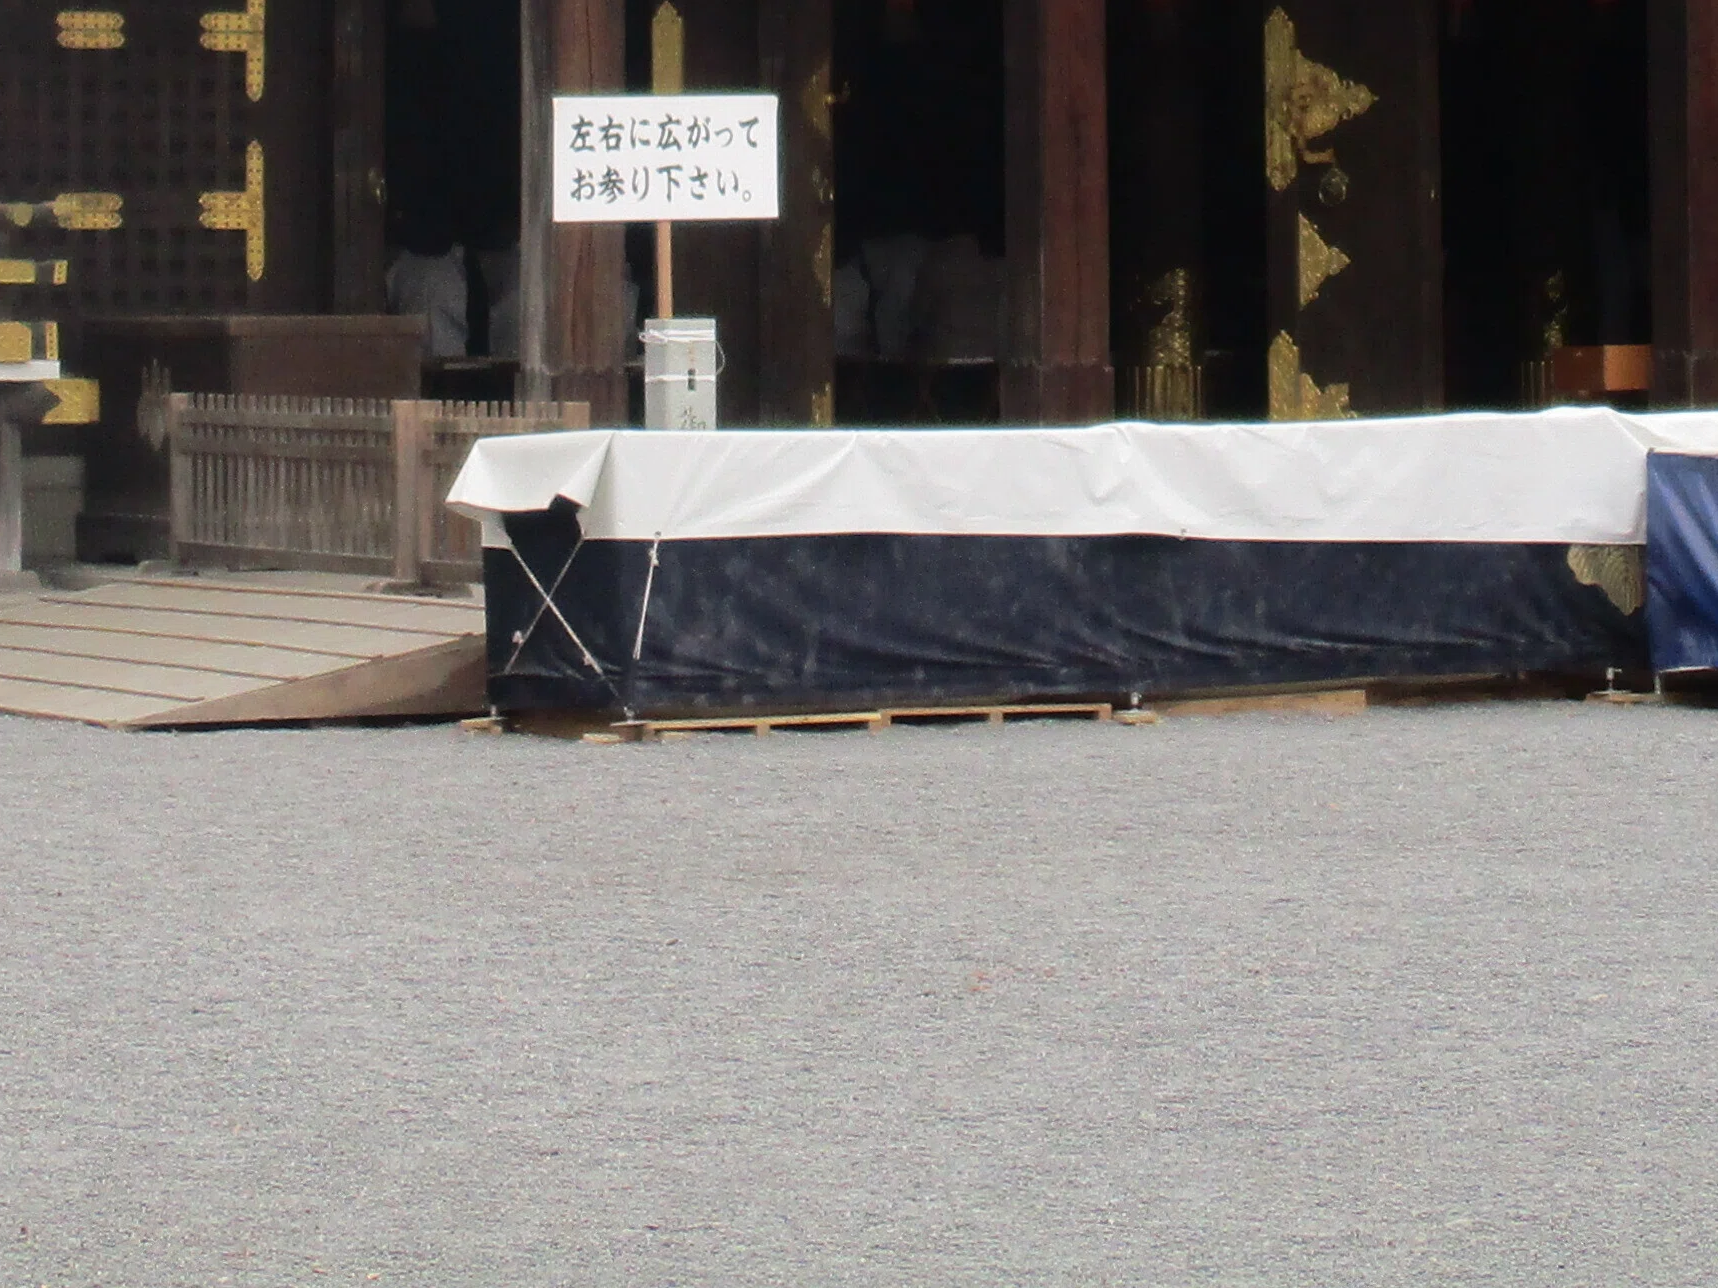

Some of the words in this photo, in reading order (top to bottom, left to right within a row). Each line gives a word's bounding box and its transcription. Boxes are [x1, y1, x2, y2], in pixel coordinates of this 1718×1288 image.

[568, 113, 761, 153] 左右に広がって
[569, 164, 752, 204] お参り下さい。
